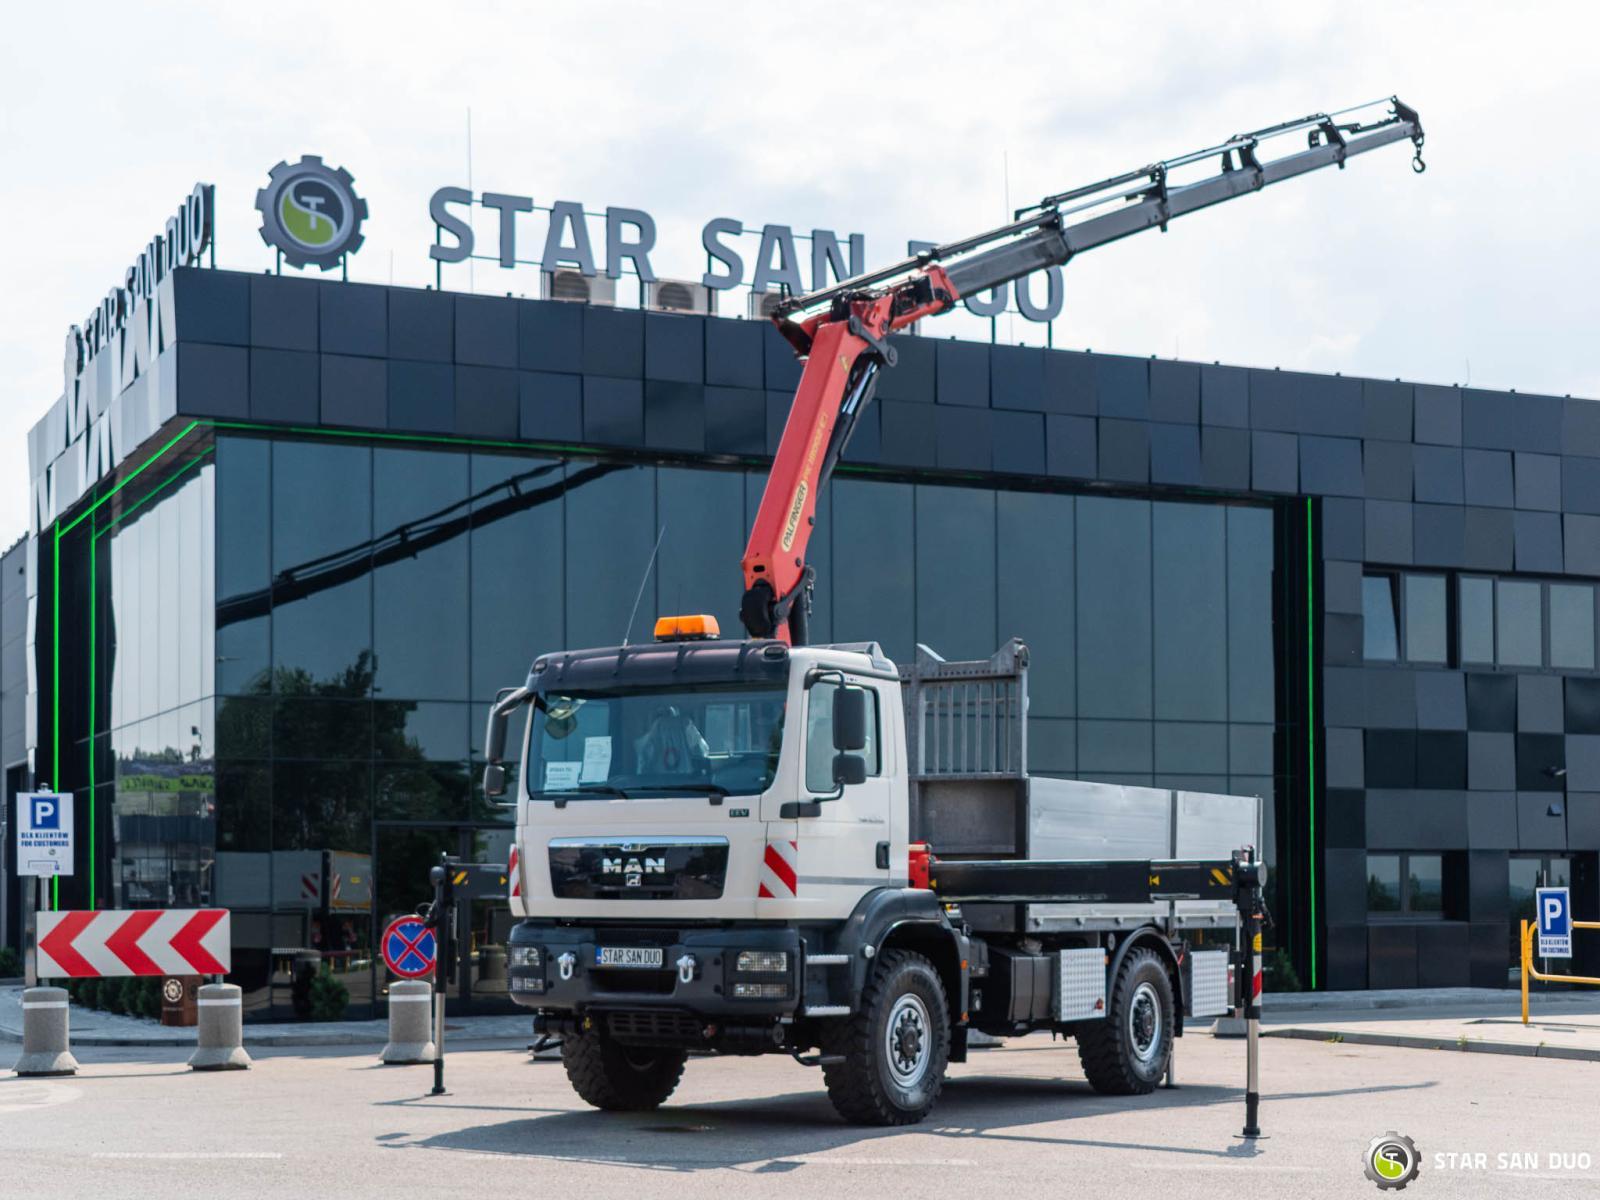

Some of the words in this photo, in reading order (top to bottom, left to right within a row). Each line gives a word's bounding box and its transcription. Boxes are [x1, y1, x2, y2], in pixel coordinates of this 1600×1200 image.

[165, 182, 209, 271] DUO
[430, 186, 656, 283] STAR
[702, 216, 865, 295] SAN
[783, 483, 807, 548] PALFINGER
[35, 801, 54, 825] P
[602, 858, 666, 873] MAN
[1544, 897, 1563, 930] P
[603, 948, 624, 963] STAR
[626, 949, 643, 963] SAN
[645, 950, 661, 964] DUO
